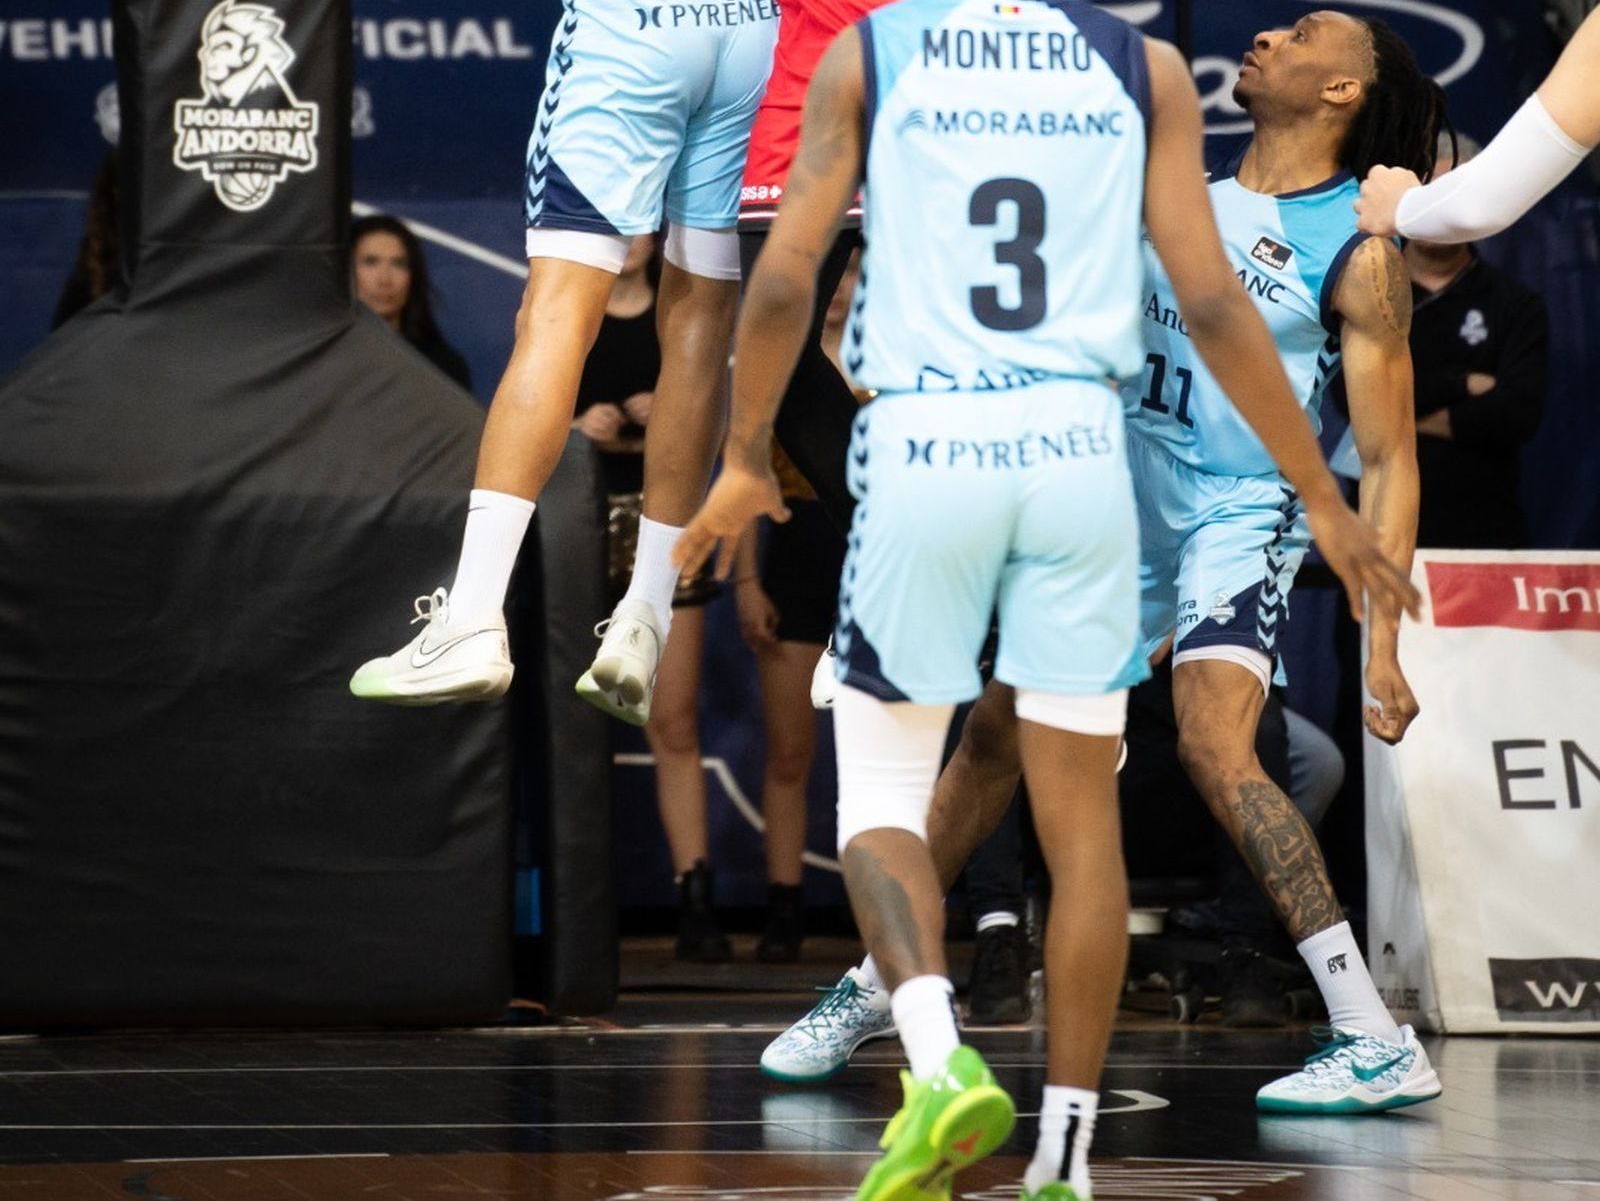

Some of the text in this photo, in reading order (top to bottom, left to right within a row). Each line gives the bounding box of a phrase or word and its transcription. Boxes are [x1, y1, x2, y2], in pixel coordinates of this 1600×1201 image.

[923, 28, 1091, 72] MONTERO
[182, 108, 311, 129] MORABANC
[935, 110, 1124, 136] MORABANC
[181, 128, 311, 161] ANDORRA
[969, 177, 1047, 332] 3
[1141, 352, 1194, 429] 11
[1512, 576, 1600, 613] Im
